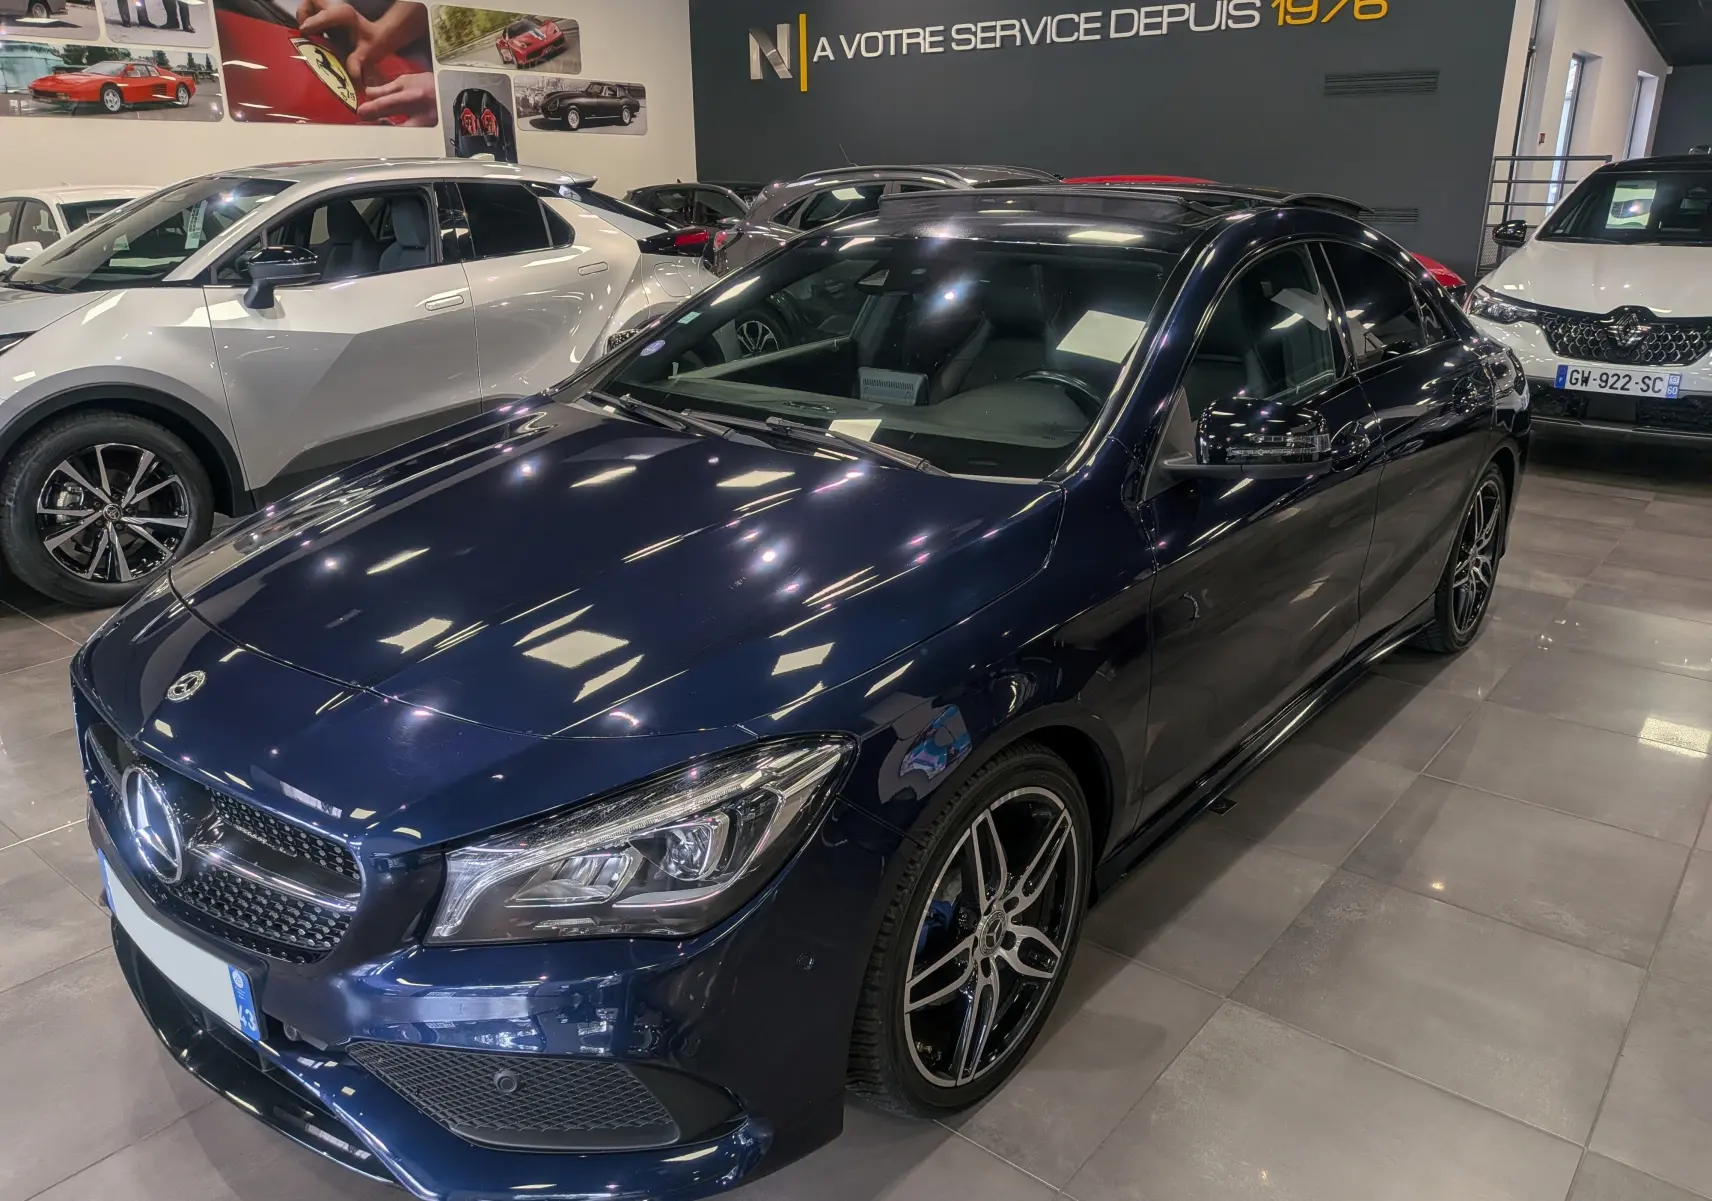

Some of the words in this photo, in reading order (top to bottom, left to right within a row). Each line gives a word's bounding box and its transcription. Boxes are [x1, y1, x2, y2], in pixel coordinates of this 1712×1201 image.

[812, 36, 835, 62] A
[839, 25, 945, 59] VOTRE
[951, 11, 1103, 51] SERVICE
[1109, 0, 1262, 39] DEPUIS
[1569, 369, 1664, 393] GW-922-SC
